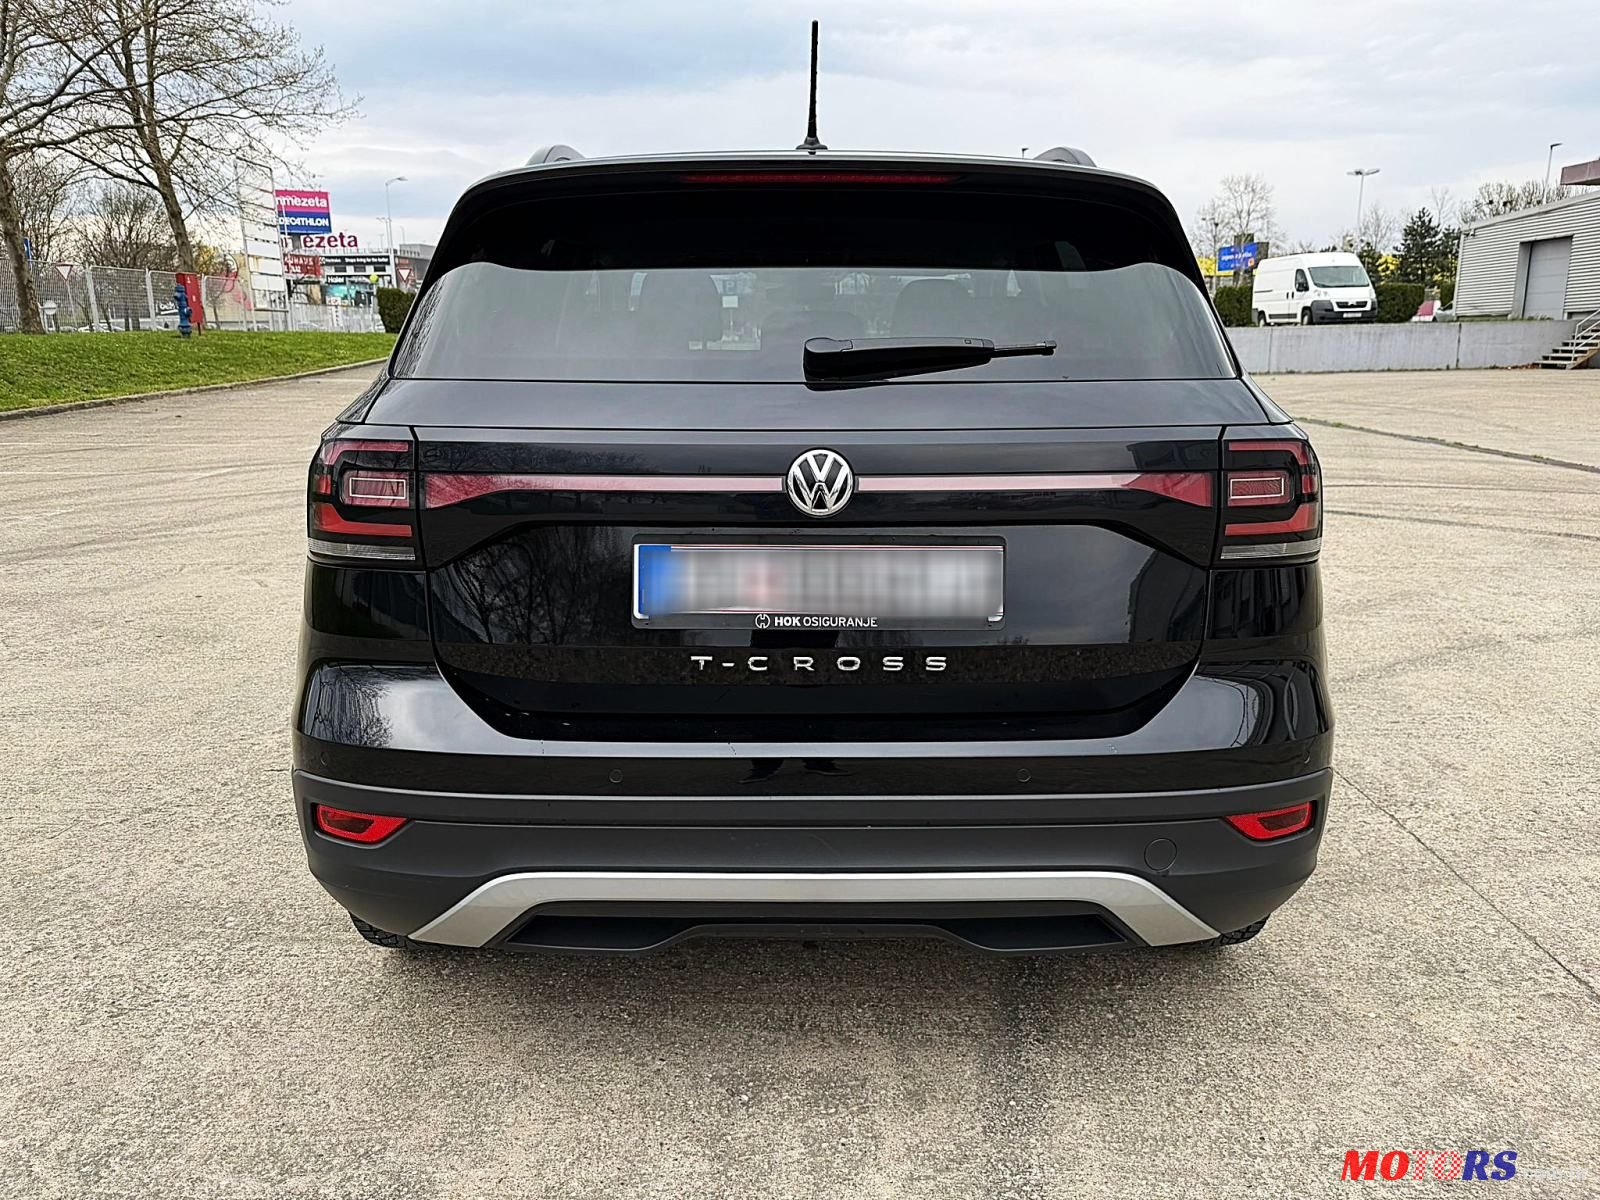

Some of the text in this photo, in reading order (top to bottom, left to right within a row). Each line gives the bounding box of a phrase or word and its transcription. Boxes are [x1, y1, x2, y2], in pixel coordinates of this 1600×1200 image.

[278, 216, 329, 227] DECATHLON
[774, 616, 878, 628] HOK OSIGURANJE
[690, 655, 948, 671] T-CROSS
